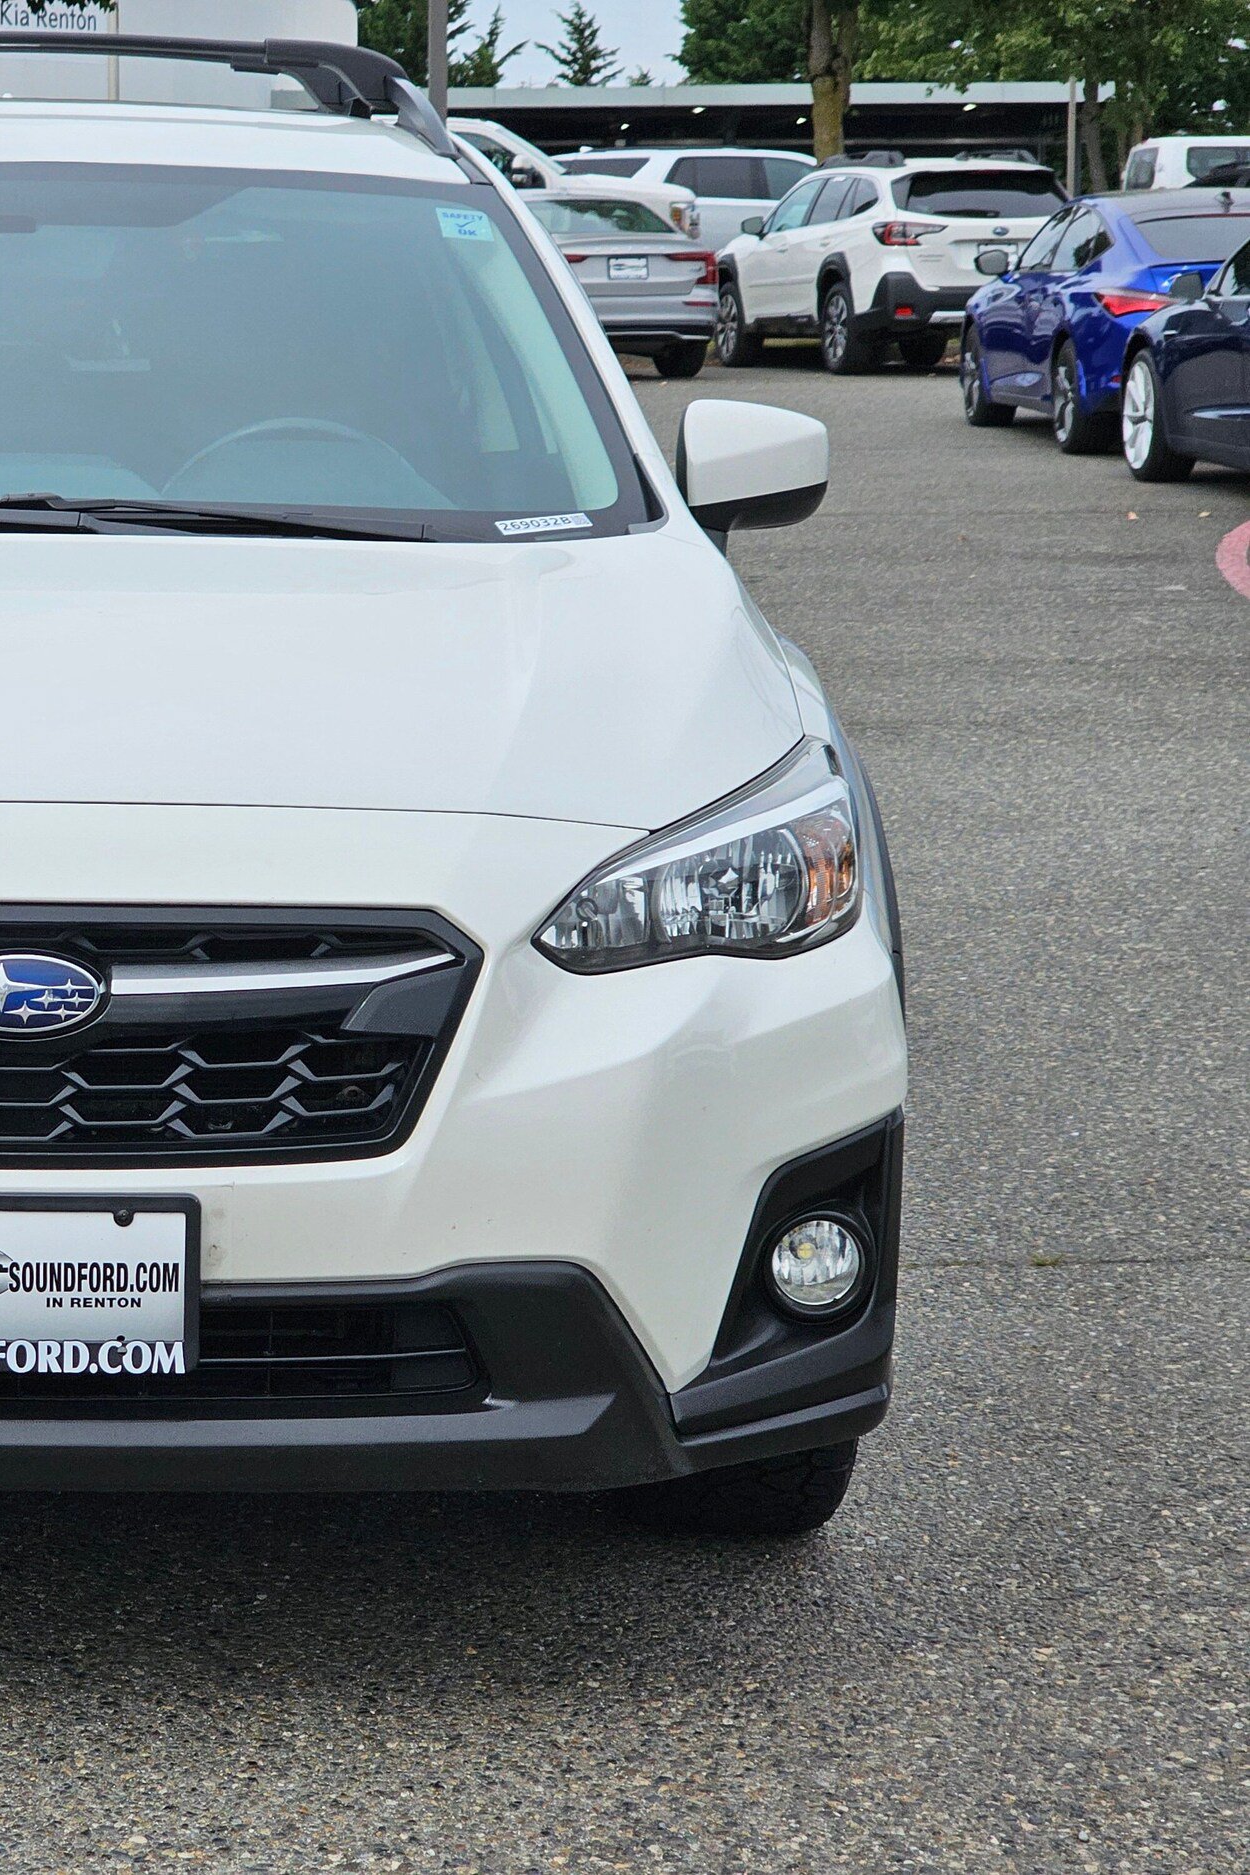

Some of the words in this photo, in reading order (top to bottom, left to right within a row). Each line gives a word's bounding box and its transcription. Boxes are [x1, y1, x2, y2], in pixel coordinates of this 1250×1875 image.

[0, 2, 30, 27] Kia
[36, 8, 97, 31] Renton
[8, 1262, 180, 1293] SOUNDFORD.COM
[45, 1298, 63, 1308] IN
[70, 1298, 142, 1308] RENTON
